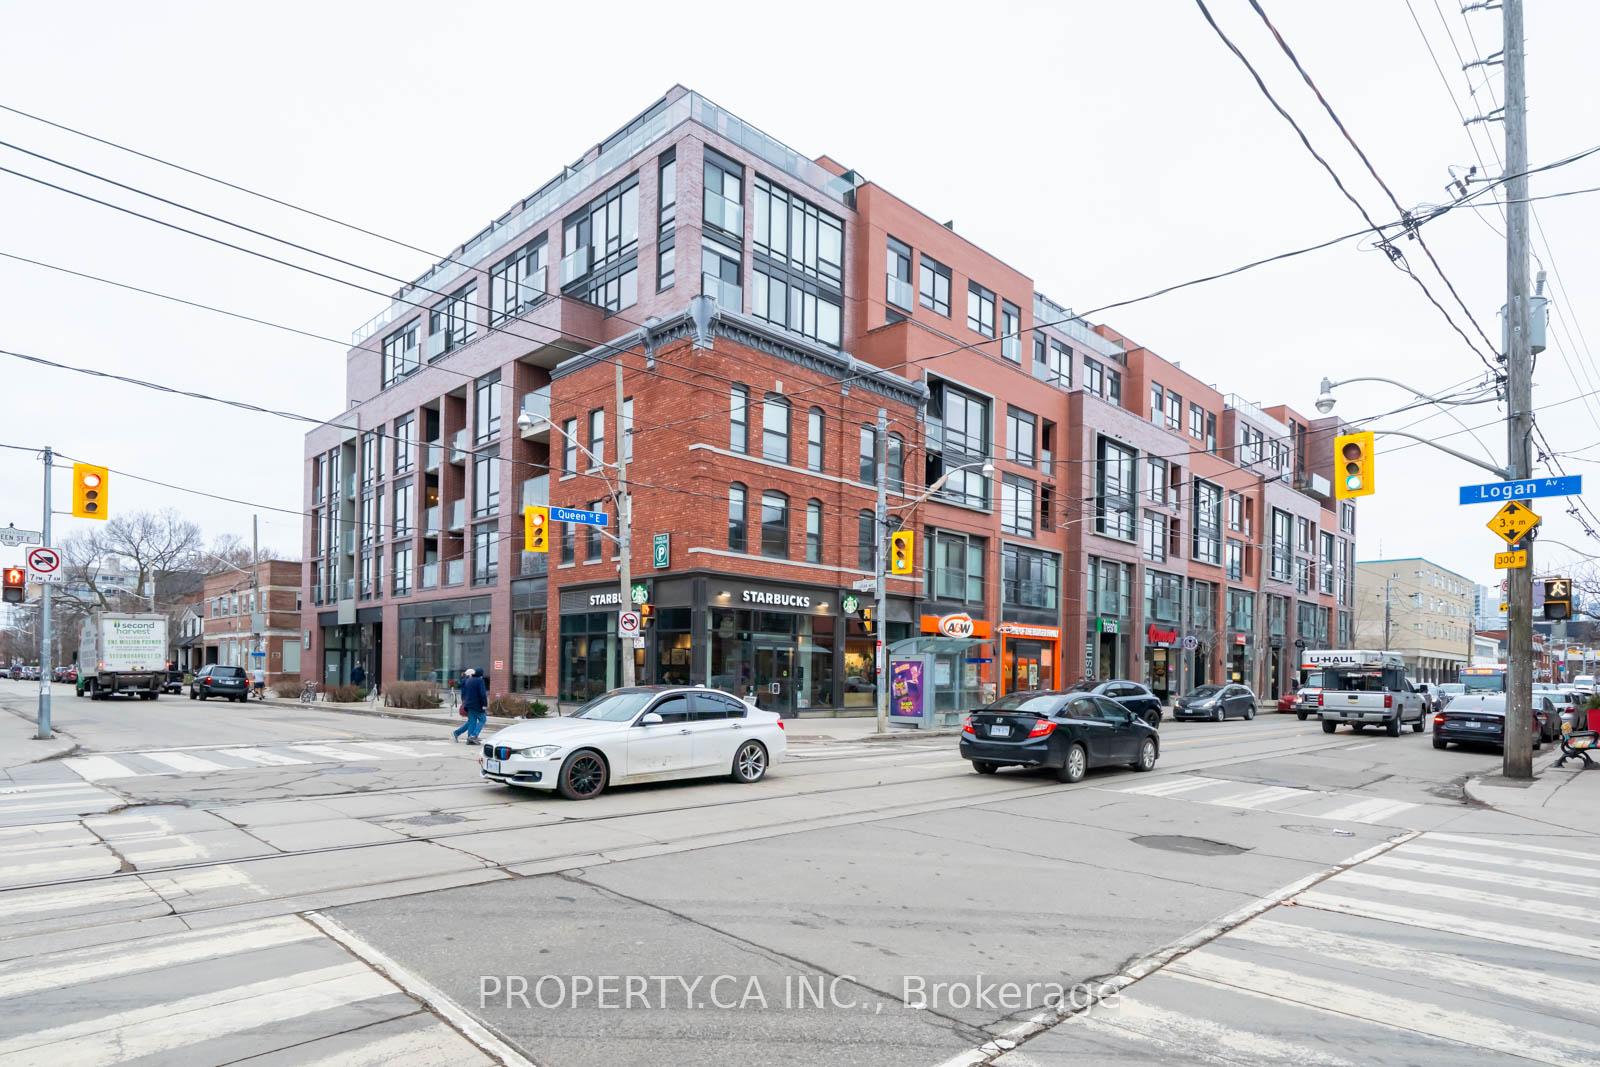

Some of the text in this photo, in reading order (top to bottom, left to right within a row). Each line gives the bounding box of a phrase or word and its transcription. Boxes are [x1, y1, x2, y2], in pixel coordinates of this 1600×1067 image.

[1480, 479, 1558, 499] Logan Av
[558, 510, 586, 521] Queen
[595, 514, 601, 523] E
[1499, 518, 1515, 528] 3.9
[1497, 556, 1516, 565] 300
[30, 573, 35, 581] 7
[590, 592, 623, 606] STARBU
[742, 590, 811, 608] STARBUCKS
[122, 621, 155, 629] second
[947, 622, 970, 634] A&W
